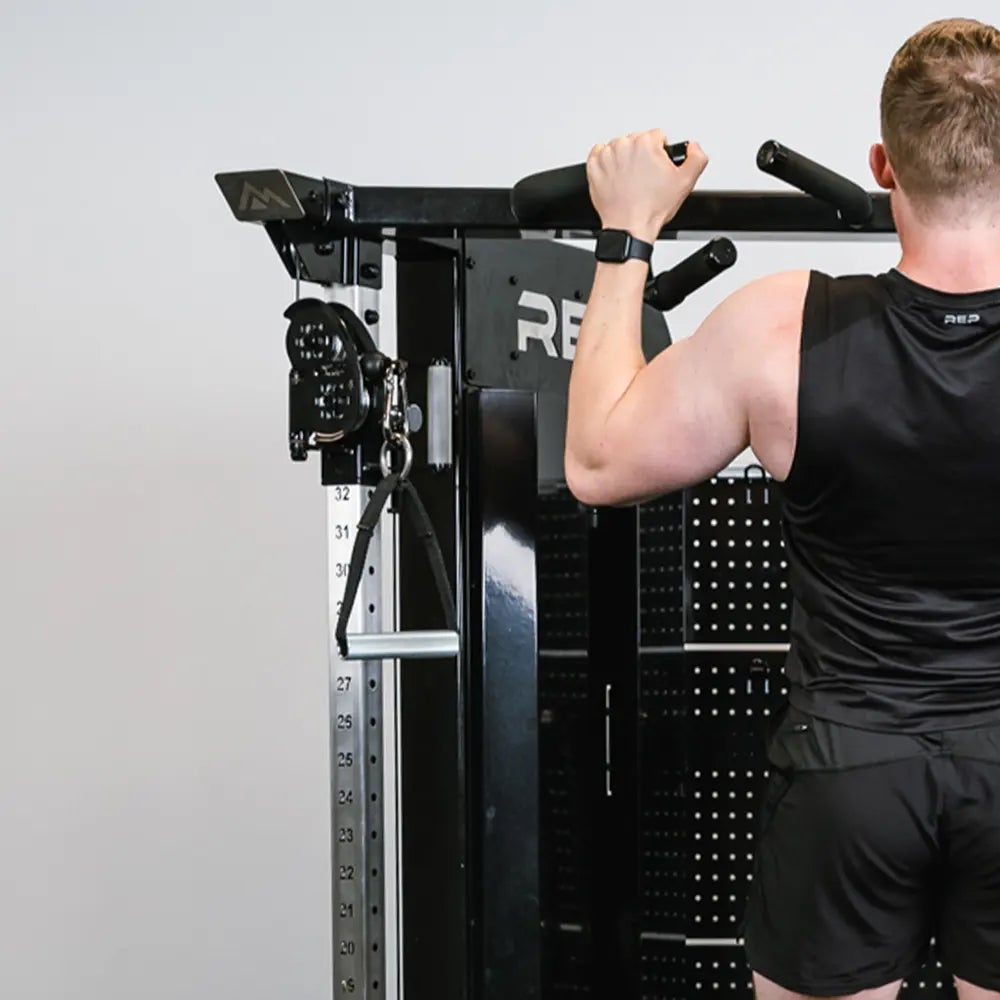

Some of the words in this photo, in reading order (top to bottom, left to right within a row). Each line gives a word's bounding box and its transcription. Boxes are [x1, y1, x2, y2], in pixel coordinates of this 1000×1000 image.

[518, 290, 588, 360] RE
[944, 314, 980, 324] REP
[335, 487, 350, 501] 32
[335, 525, 349, 539] 31
[336, 676, 352, 691] 27
[338, 789, 354, 805] 24
[338, 827, 354, 842] 23
[339, 865, 354, 880] 22
[339, 903, 354, 918] 21
